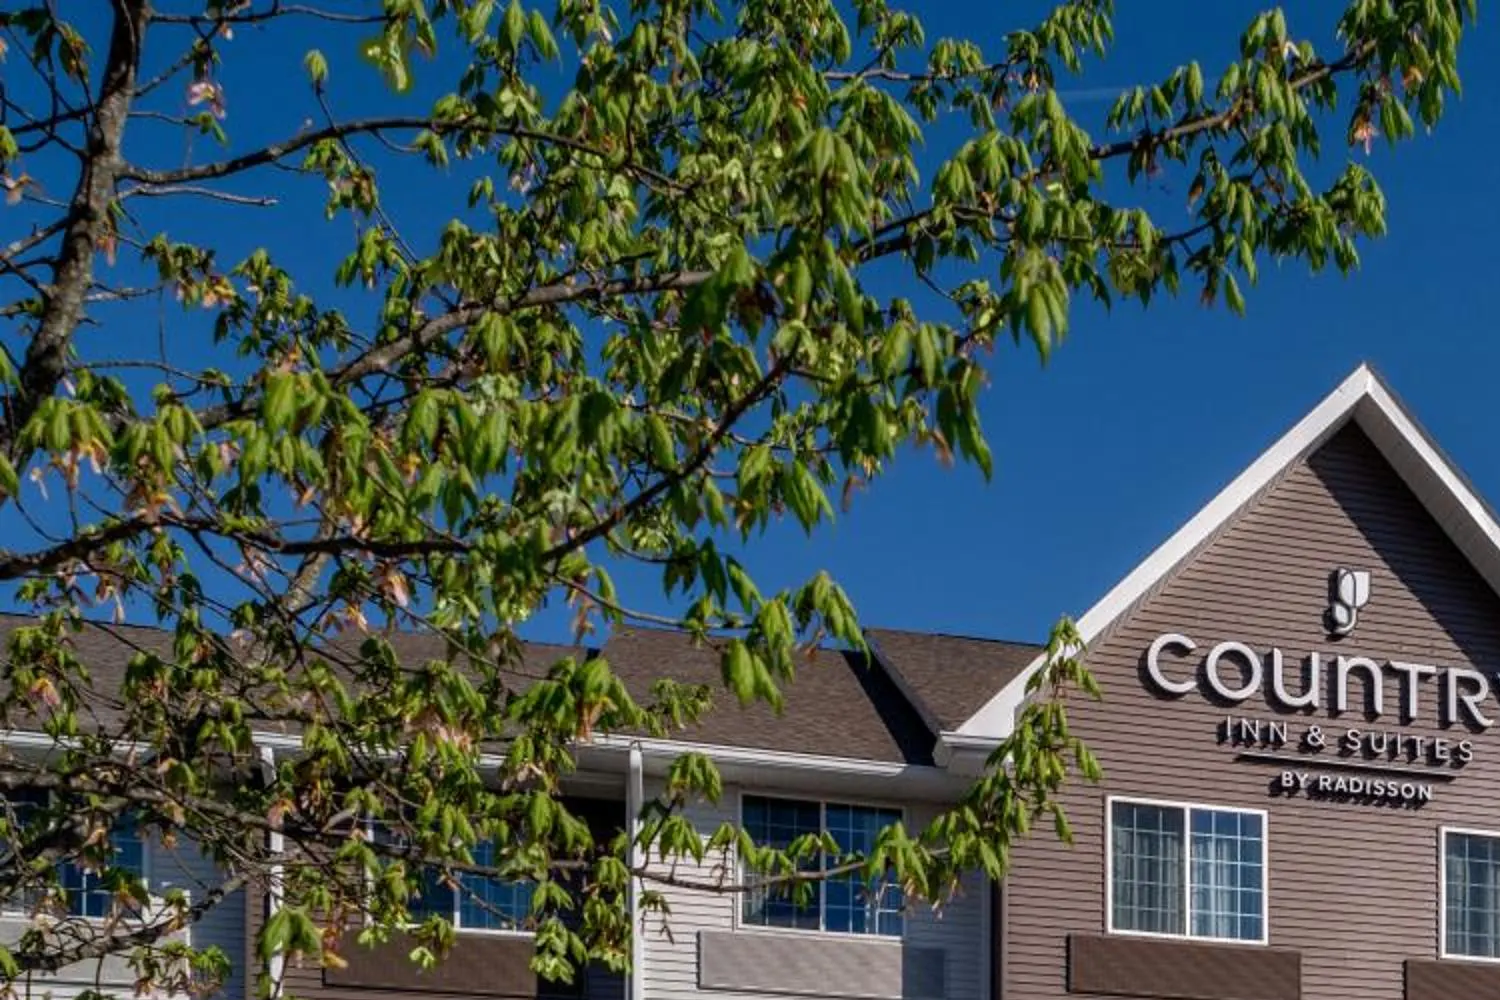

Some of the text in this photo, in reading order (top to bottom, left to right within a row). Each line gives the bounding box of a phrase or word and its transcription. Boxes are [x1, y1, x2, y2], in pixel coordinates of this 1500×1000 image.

[1226, 715, 1474, 762] INN & SUITES
[1281, 771, 1433, 800] BY RADISSON
